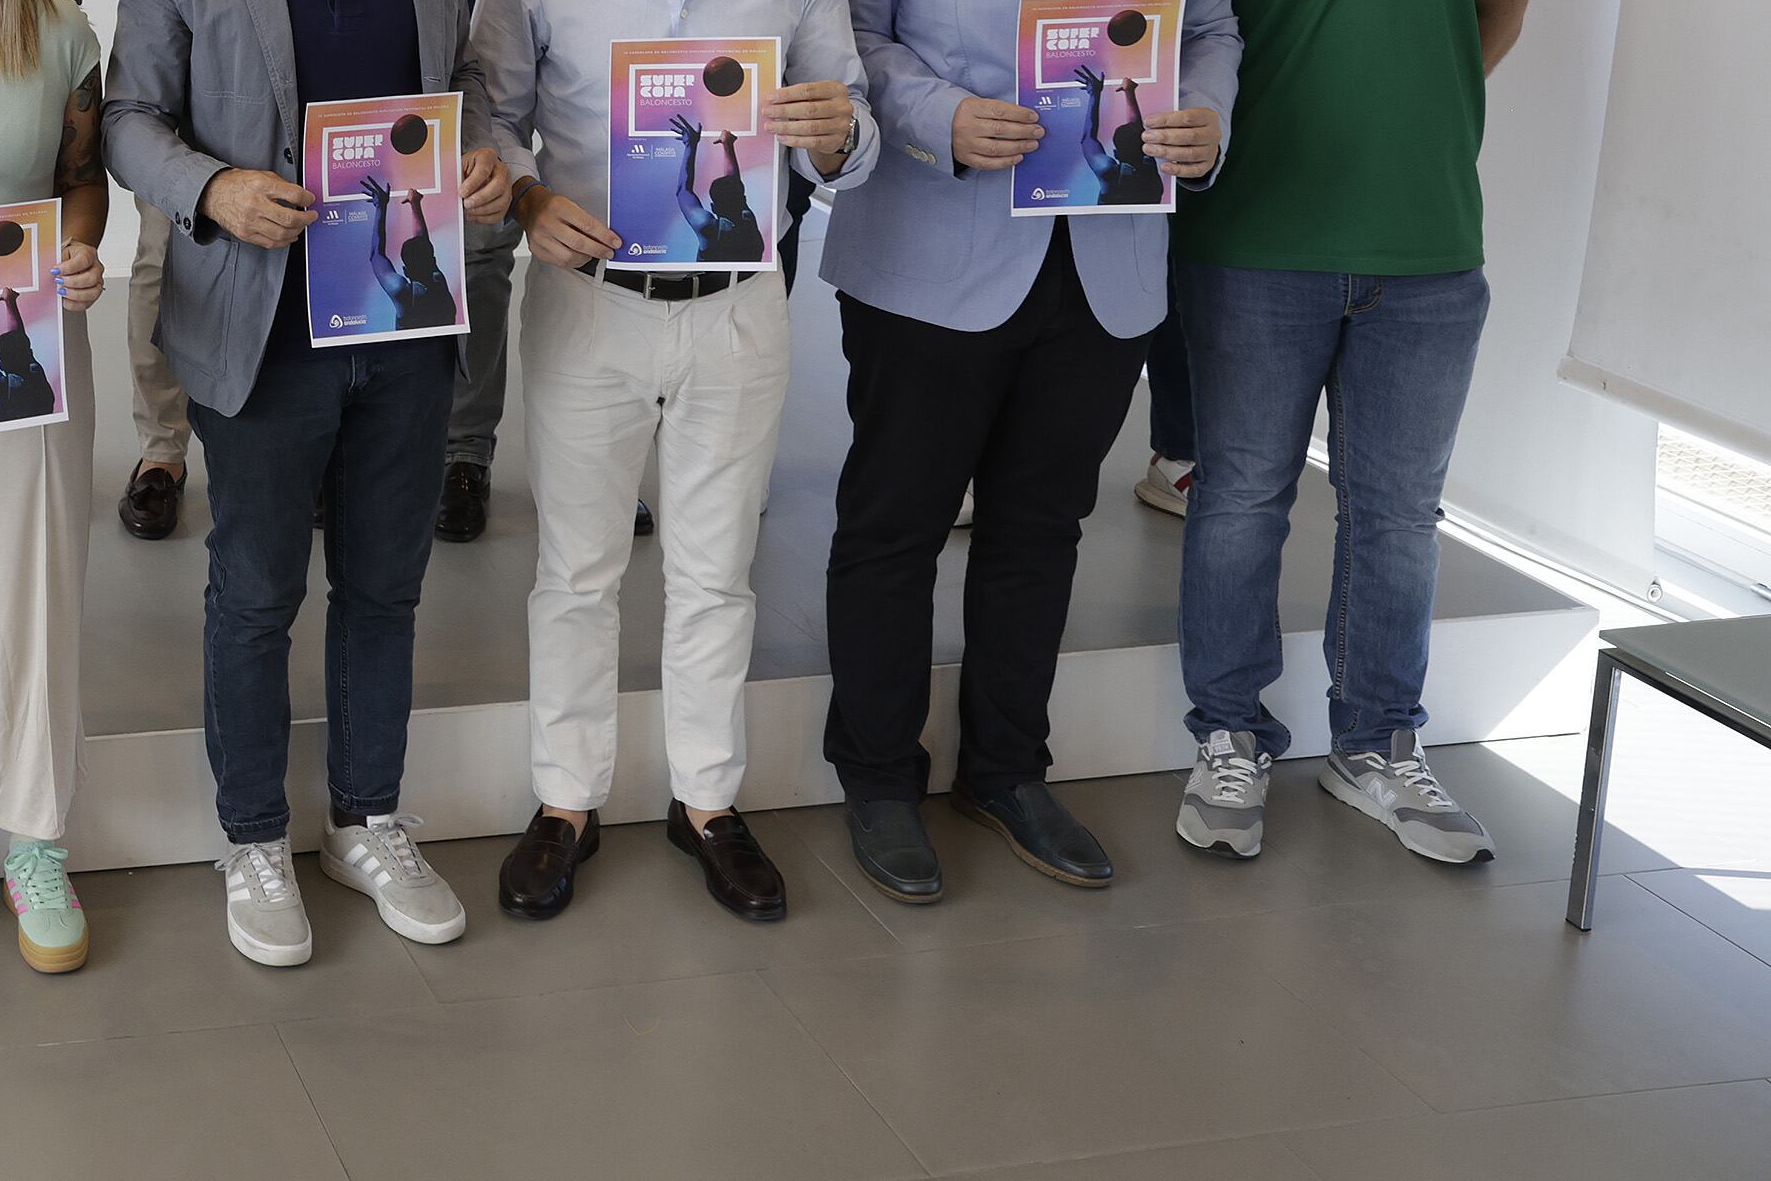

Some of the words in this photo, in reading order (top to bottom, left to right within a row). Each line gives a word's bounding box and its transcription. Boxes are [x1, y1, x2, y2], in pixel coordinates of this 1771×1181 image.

[1045, 49, 1097, 59] BALONCESTO
[639, 74, 695, 87] SUPER
[639, 86, 686, 98] COPA
[639, 98, 693, 107] BALONCESTO
[332, 134, 384, 149] SUPER
[332, 147, 375, 161] COPA
[332, 159, 381, 170] BALONCESTO
